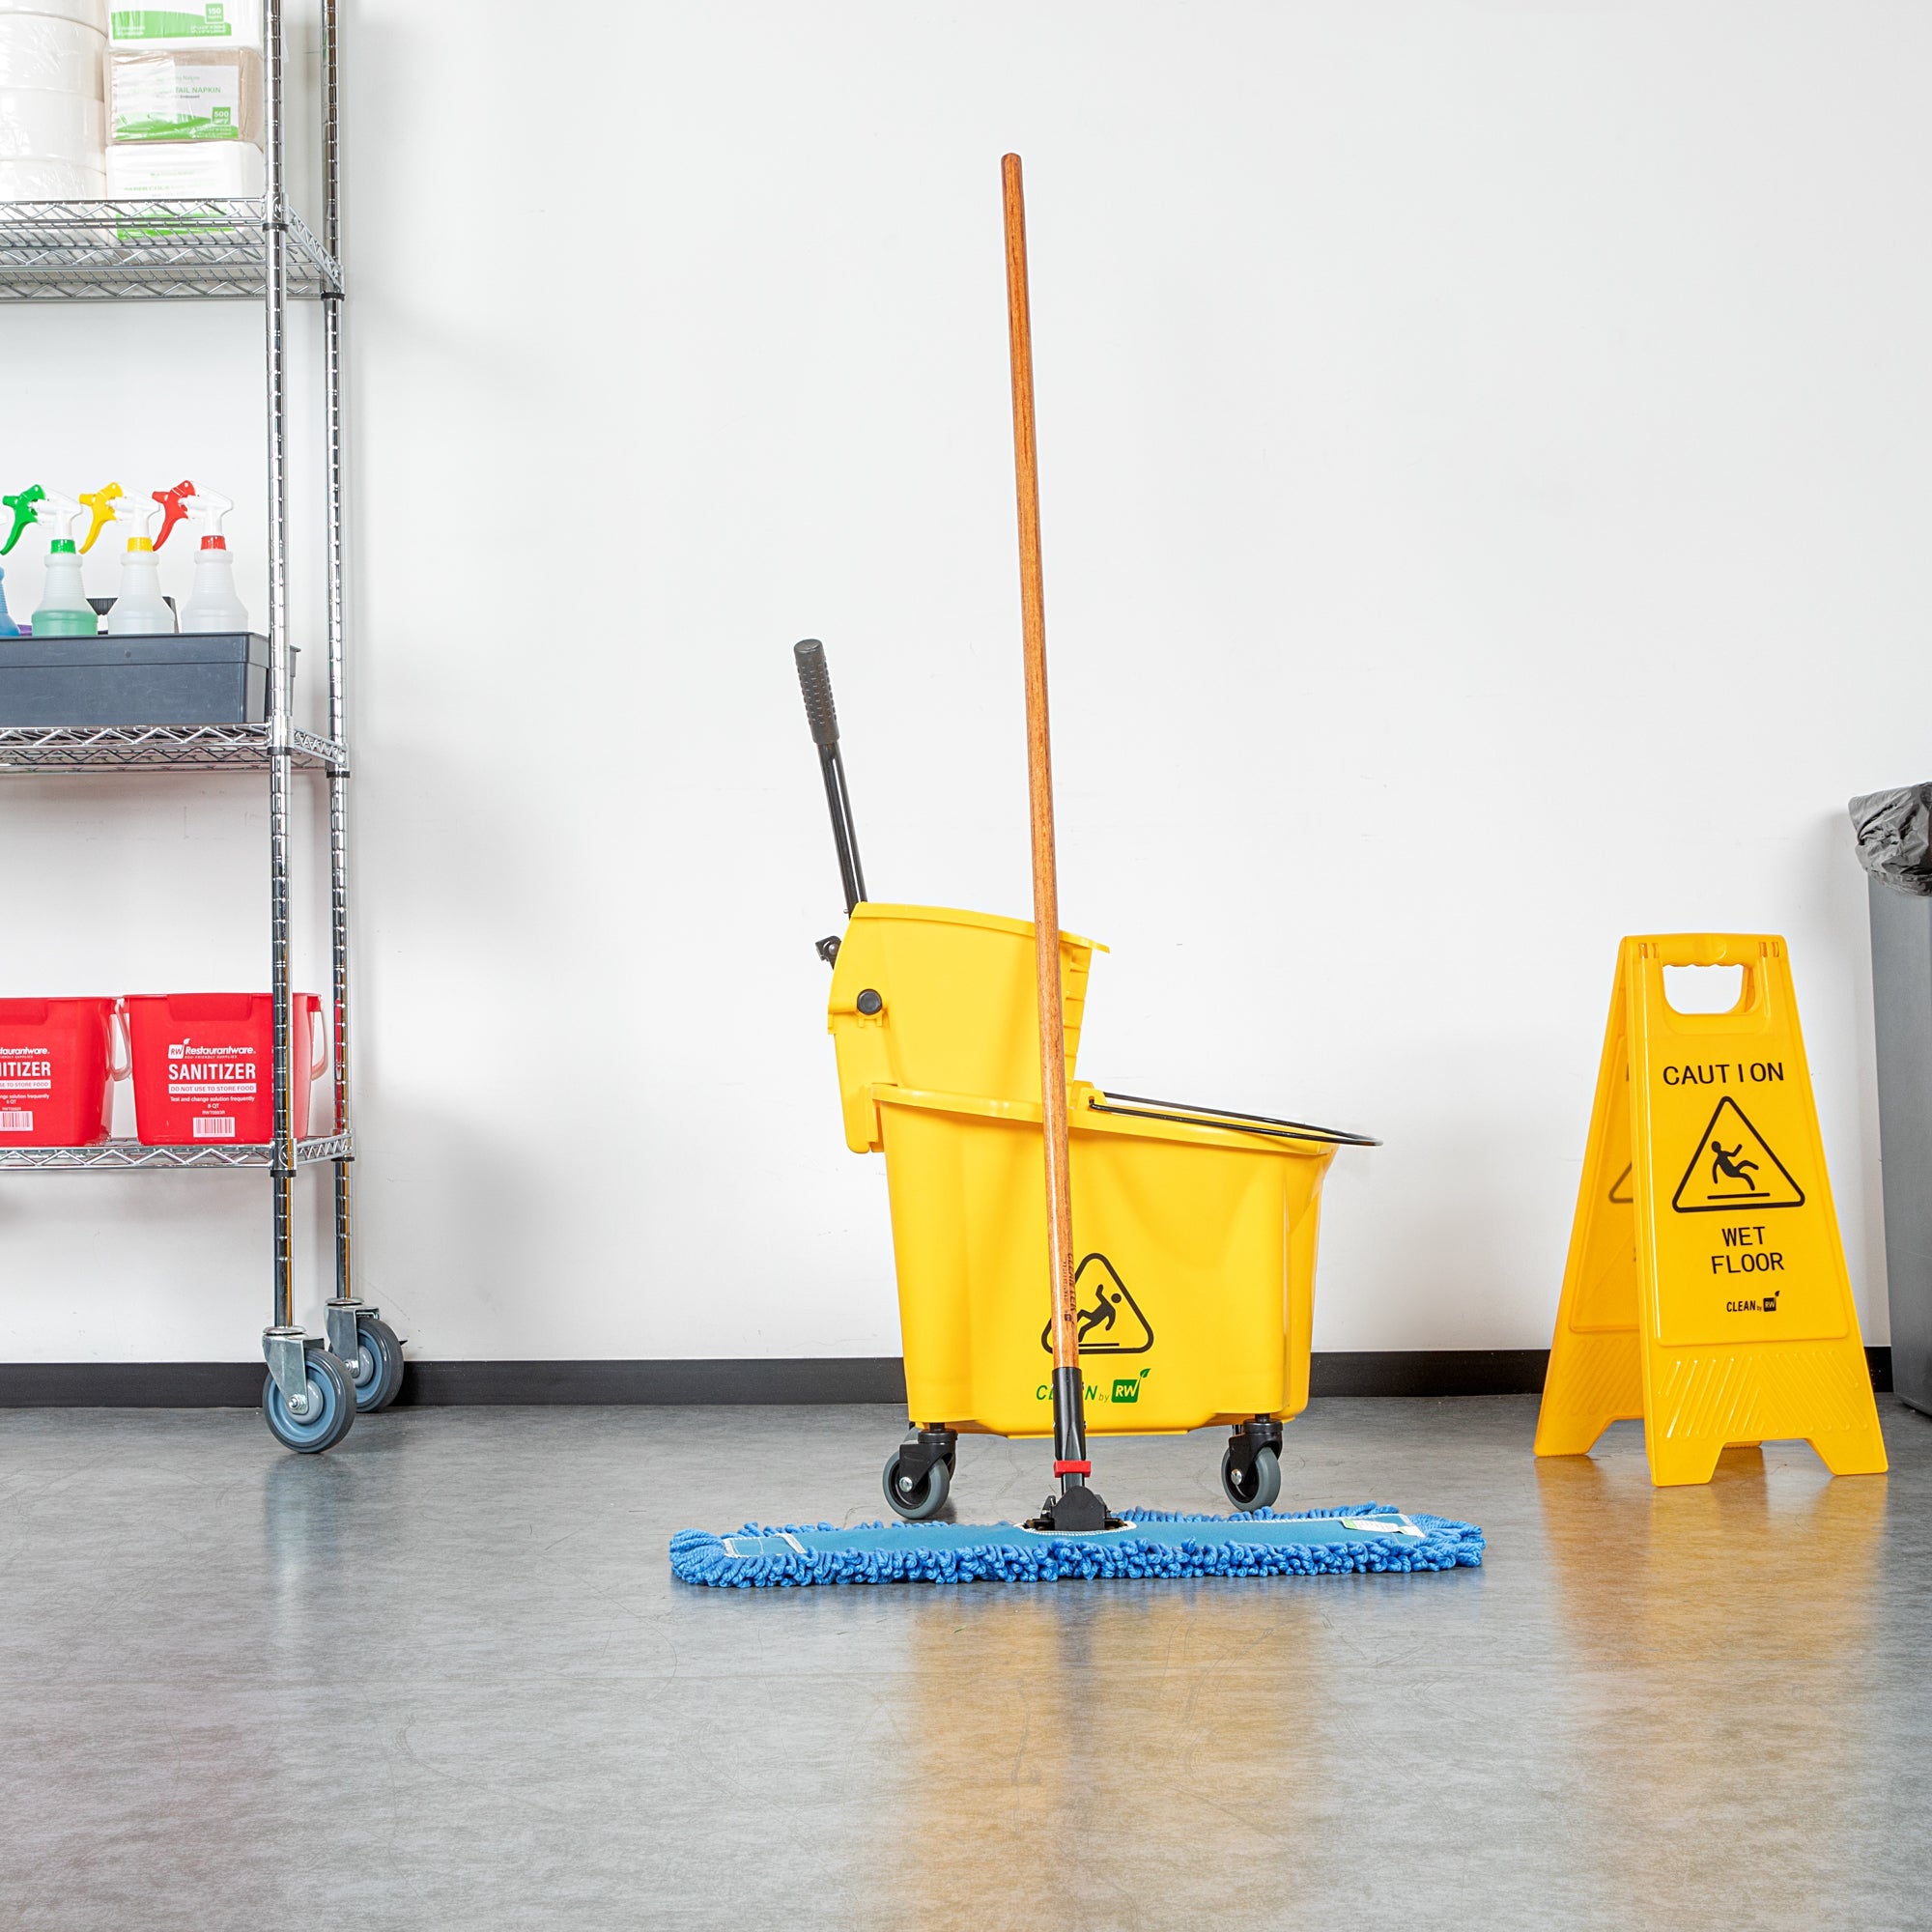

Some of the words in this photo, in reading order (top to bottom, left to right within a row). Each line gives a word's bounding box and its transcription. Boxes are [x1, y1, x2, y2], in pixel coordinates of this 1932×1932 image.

[168, 1063, 256, 1080] SANITIZER
[1662, 1062, 1784, 1086] CAUTION
[1721, 1226, 1766, 1247] WET
[1711, 1252, 1785, 1274] FLOOR
[1726, 1300, 1756, 1312] CLEAN
[1098, 1393, 1110, 1403] by
[1115, 1384, 1137, 1398] RW
